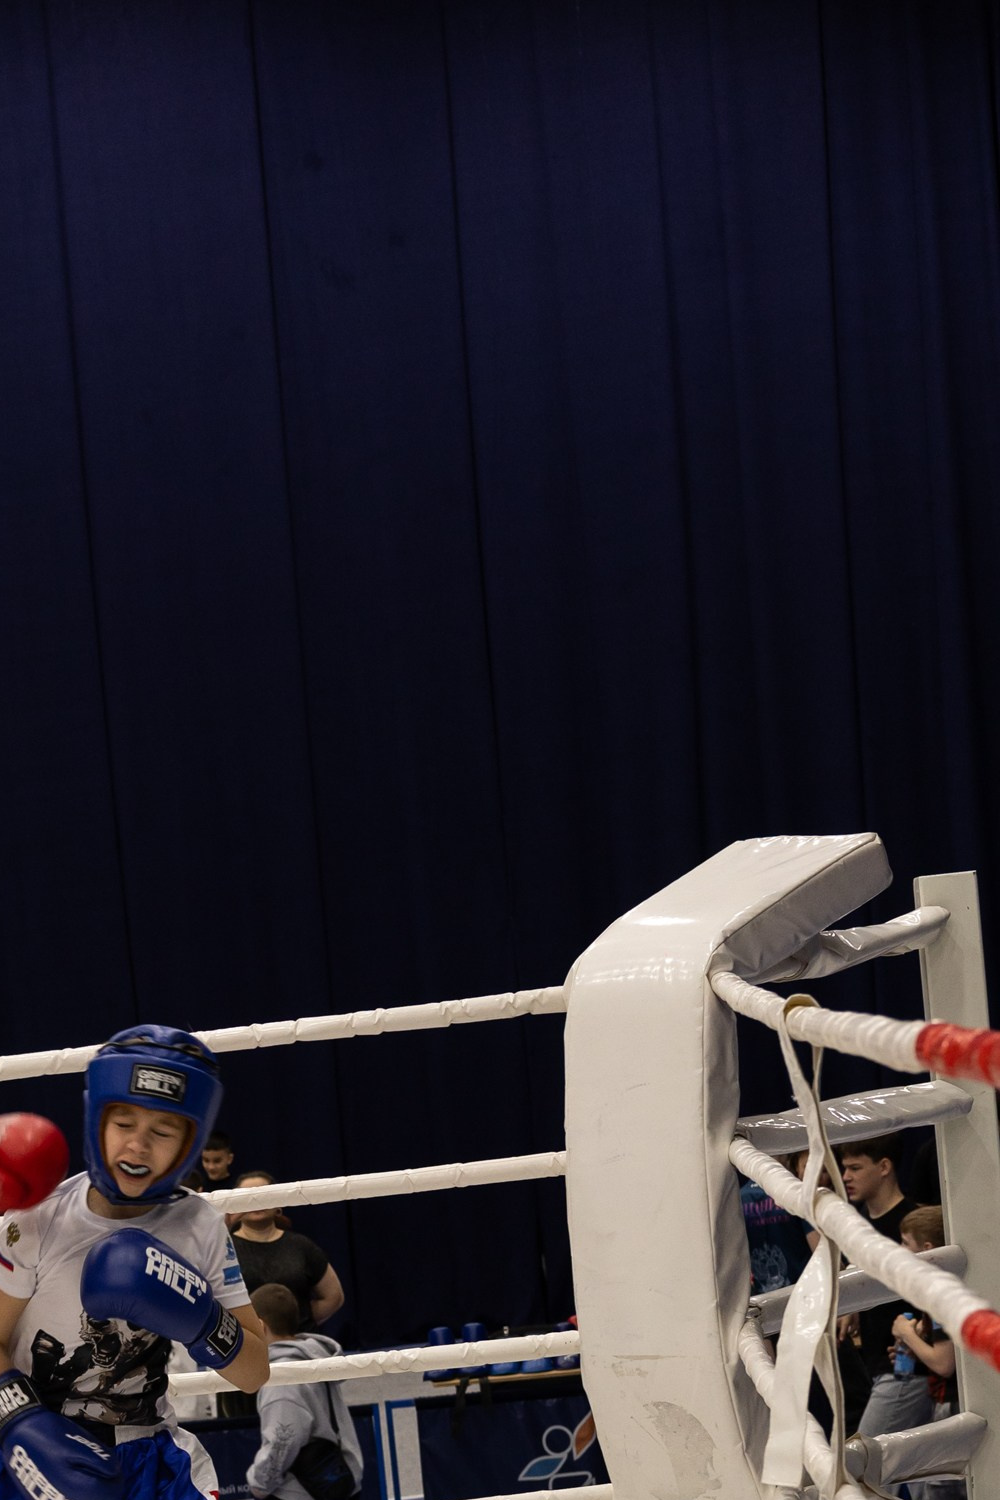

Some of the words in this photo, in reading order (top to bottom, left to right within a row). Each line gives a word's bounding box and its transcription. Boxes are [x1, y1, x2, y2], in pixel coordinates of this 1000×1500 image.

[136, 1078, 174, 1095] HILL
[137, 1069, 181, 1087] GREEN
[144, 1257, 197, 1304] HILL
[145, 1246, 207, 1294] GREEN
